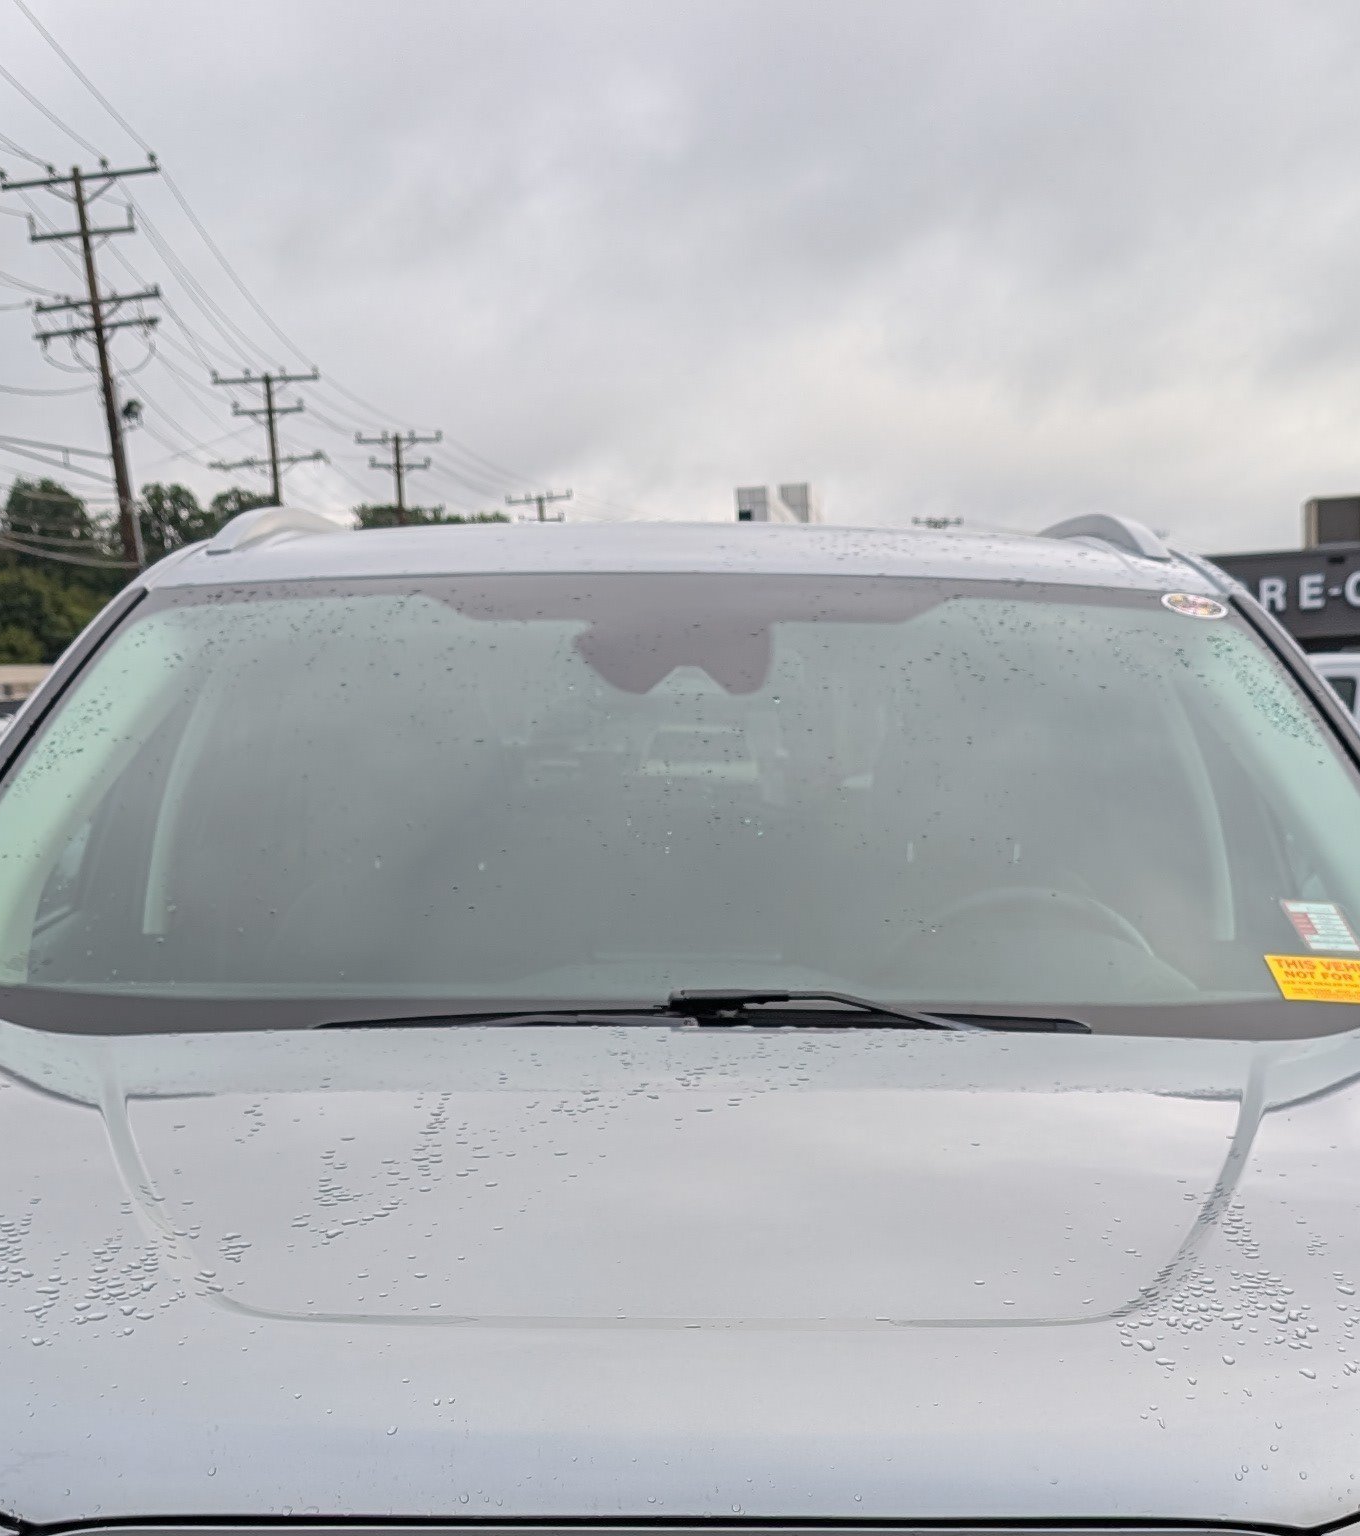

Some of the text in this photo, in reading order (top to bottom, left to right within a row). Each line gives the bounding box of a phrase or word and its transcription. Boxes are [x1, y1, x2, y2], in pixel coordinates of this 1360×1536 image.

[1274, 959, 1317, 970] THIS
[1284, 971, 1316, 979] NOT
[1321, 972, 1353, 982] FOR
